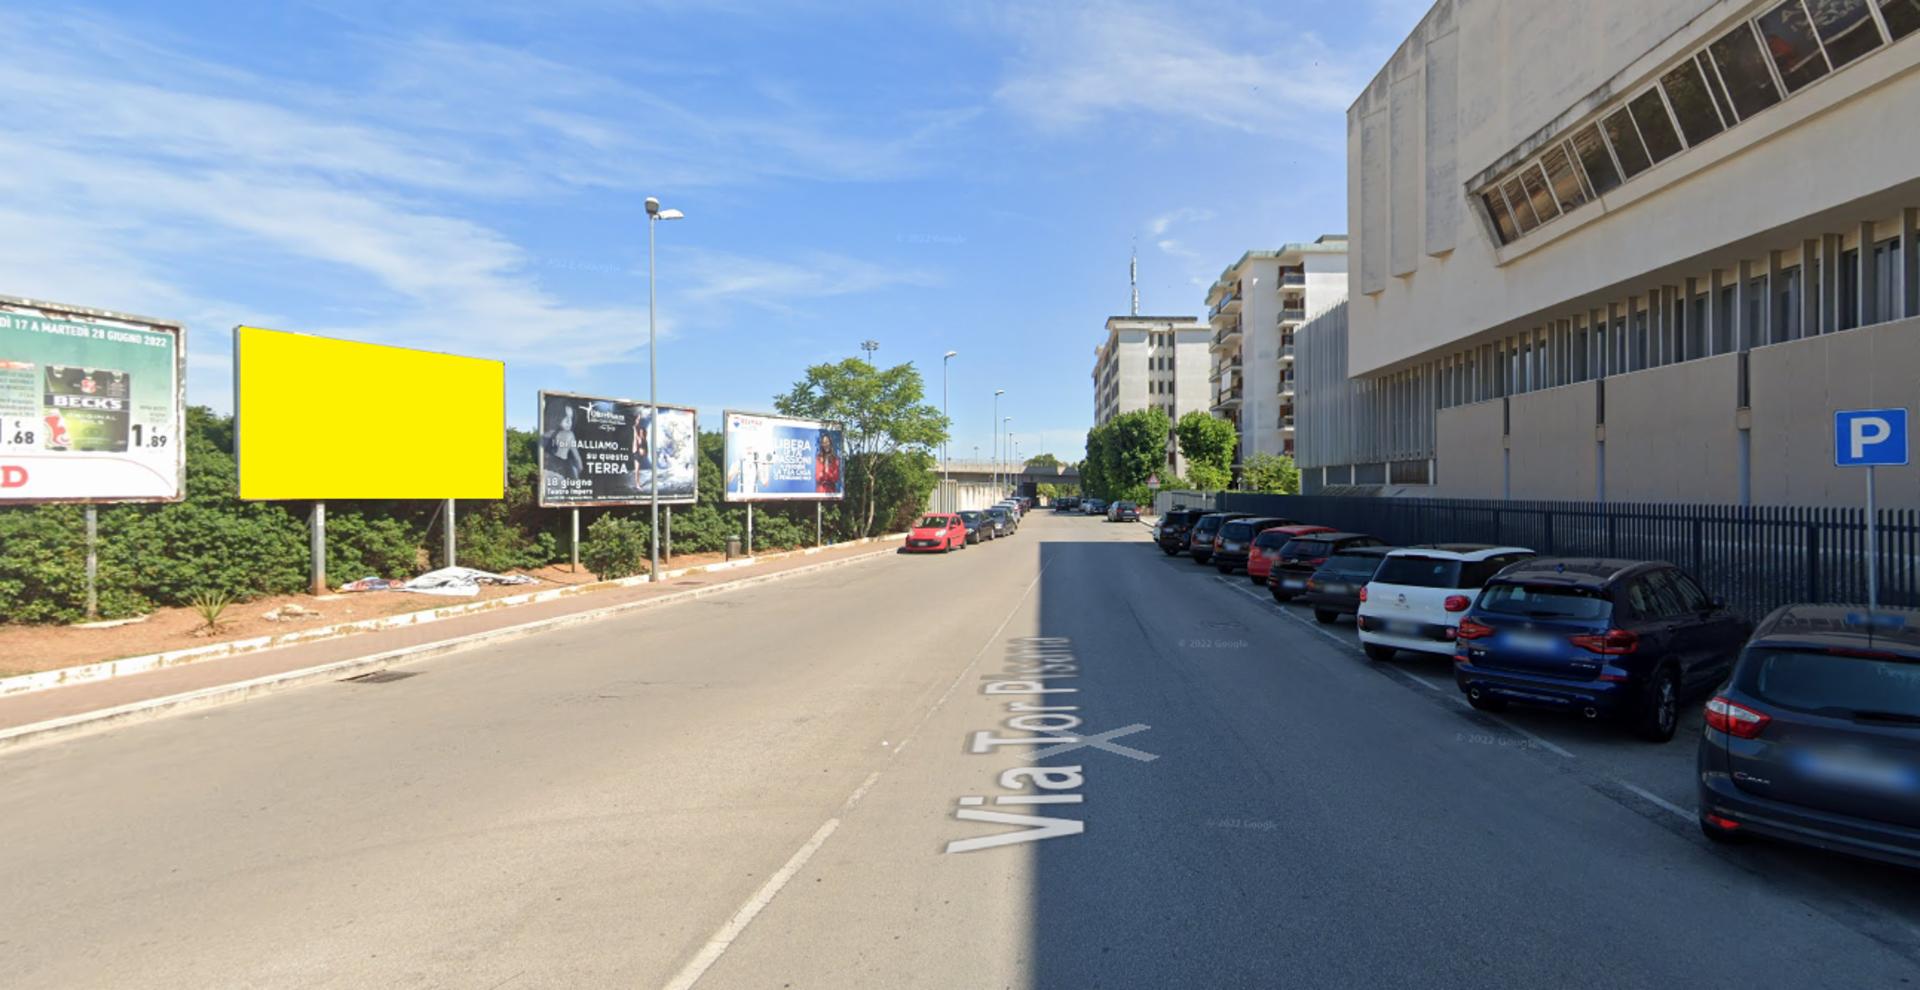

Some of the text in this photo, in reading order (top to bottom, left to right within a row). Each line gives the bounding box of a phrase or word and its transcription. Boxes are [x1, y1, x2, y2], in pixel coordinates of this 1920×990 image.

[15, 319, 28, 330] 17
[31, 321, 39, 332] A
[41, 322, 89, 337] MARTEDÌ
[92, 329, 105, 339] 28
[107, 330, 142, 344] GIUGNO
[144, 335, 167, 348] 2022
[571, 439, 619, 451] BALLIAMO
[1850, 417, 1891, 458] P
[586, 462, 628, 474] TERRA
